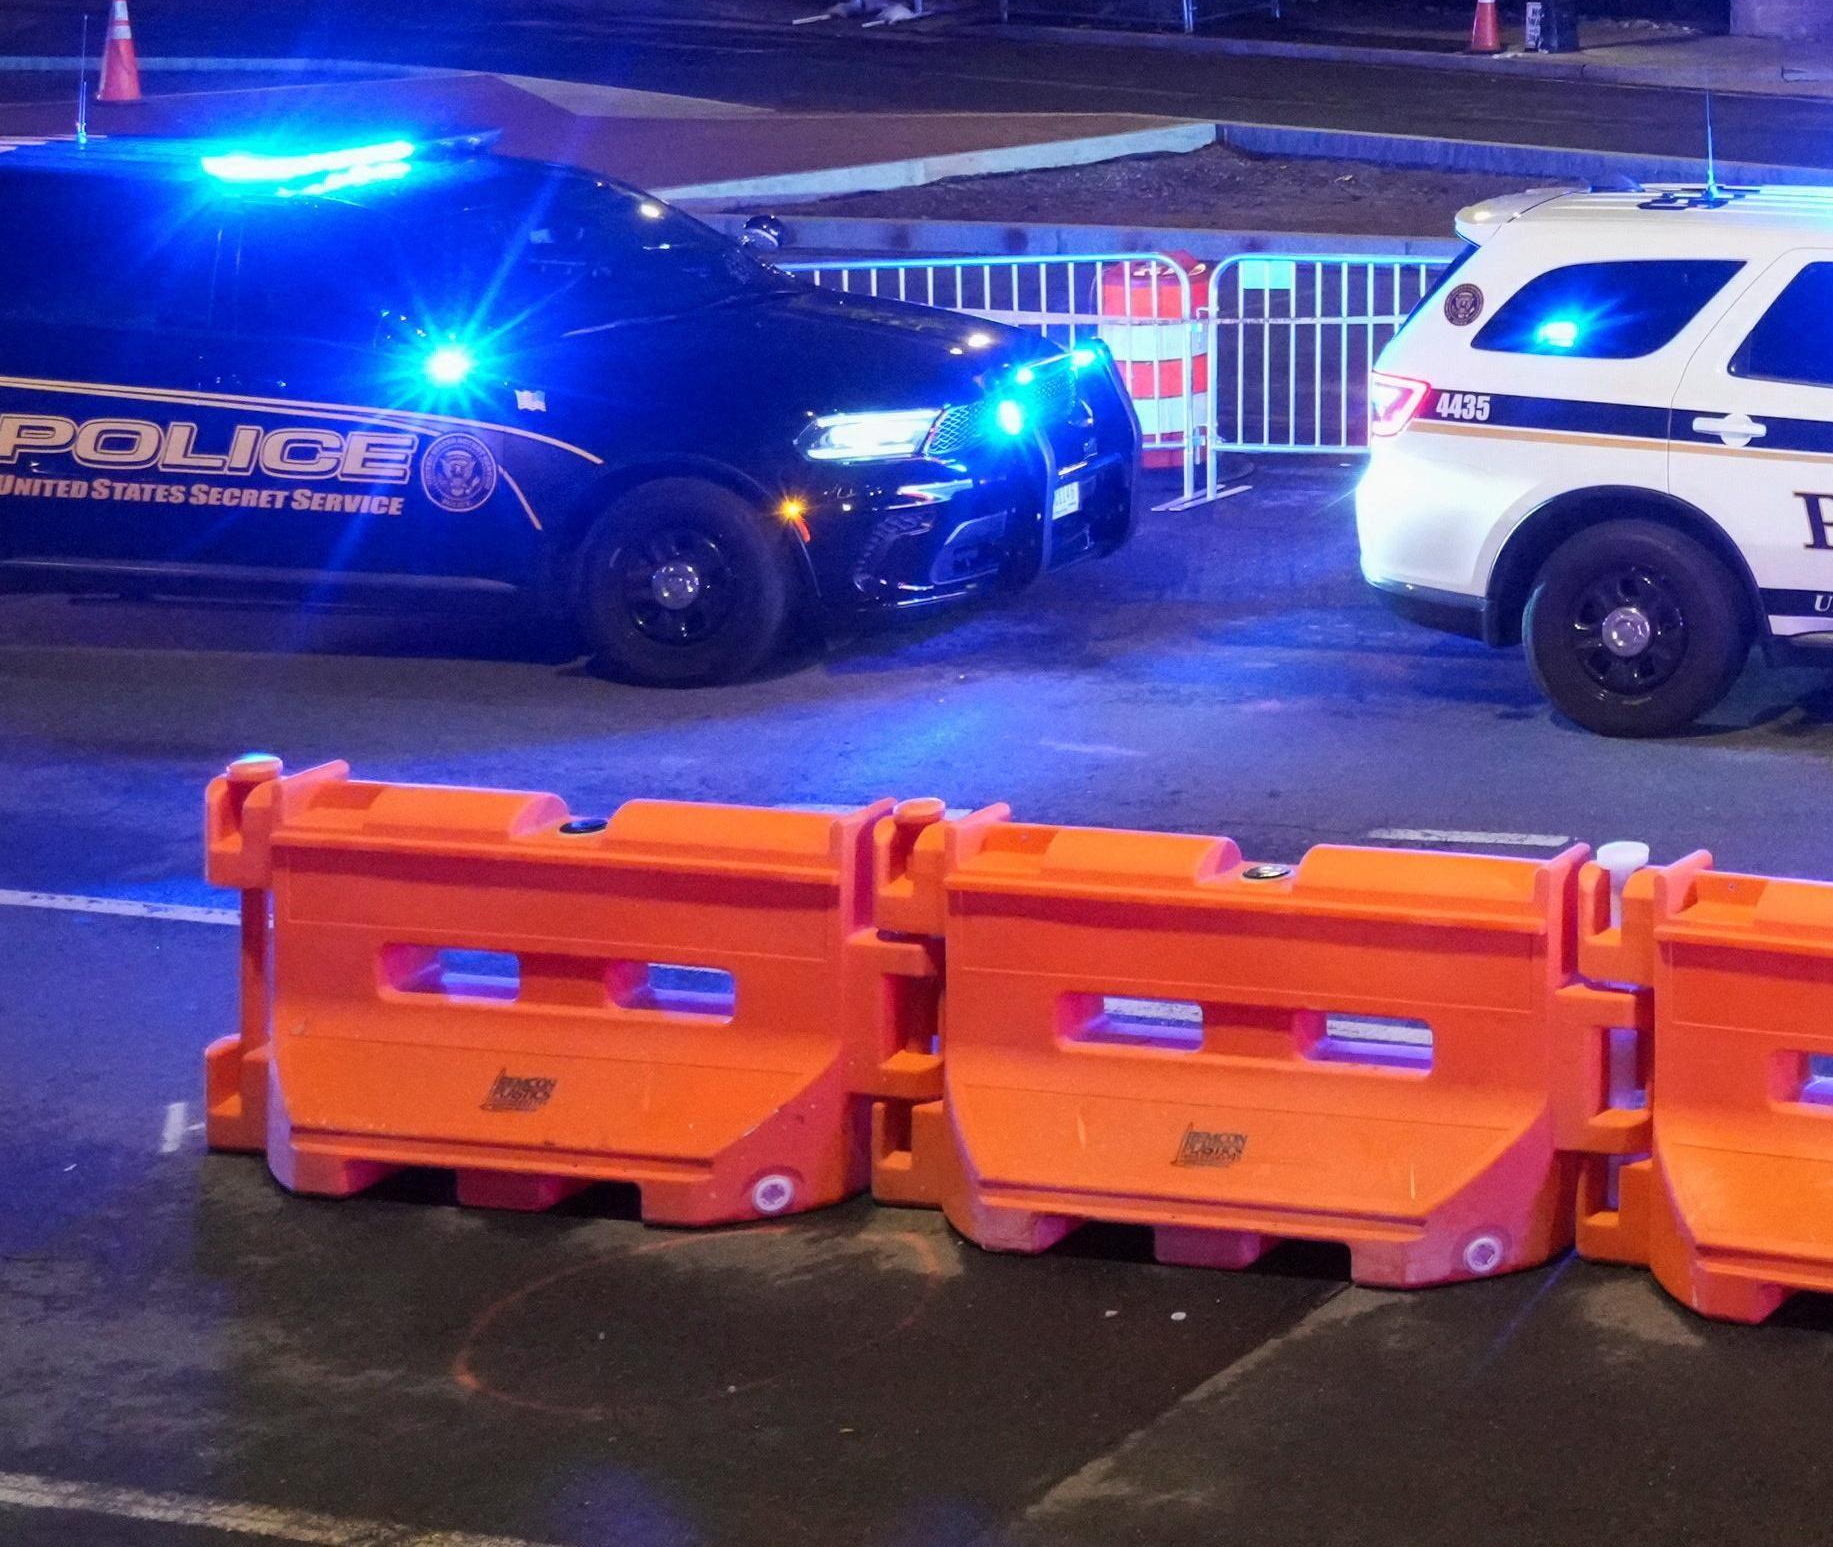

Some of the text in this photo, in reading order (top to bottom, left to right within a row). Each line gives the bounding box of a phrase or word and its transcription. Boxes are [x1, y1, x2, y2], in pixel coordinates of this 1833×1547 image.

[1436, 392, 1491, 422] 4435
[0, 413, 419, 485] POLICE
[0, 475, 405, 516] UNITED STATES SECRET SERVICE
